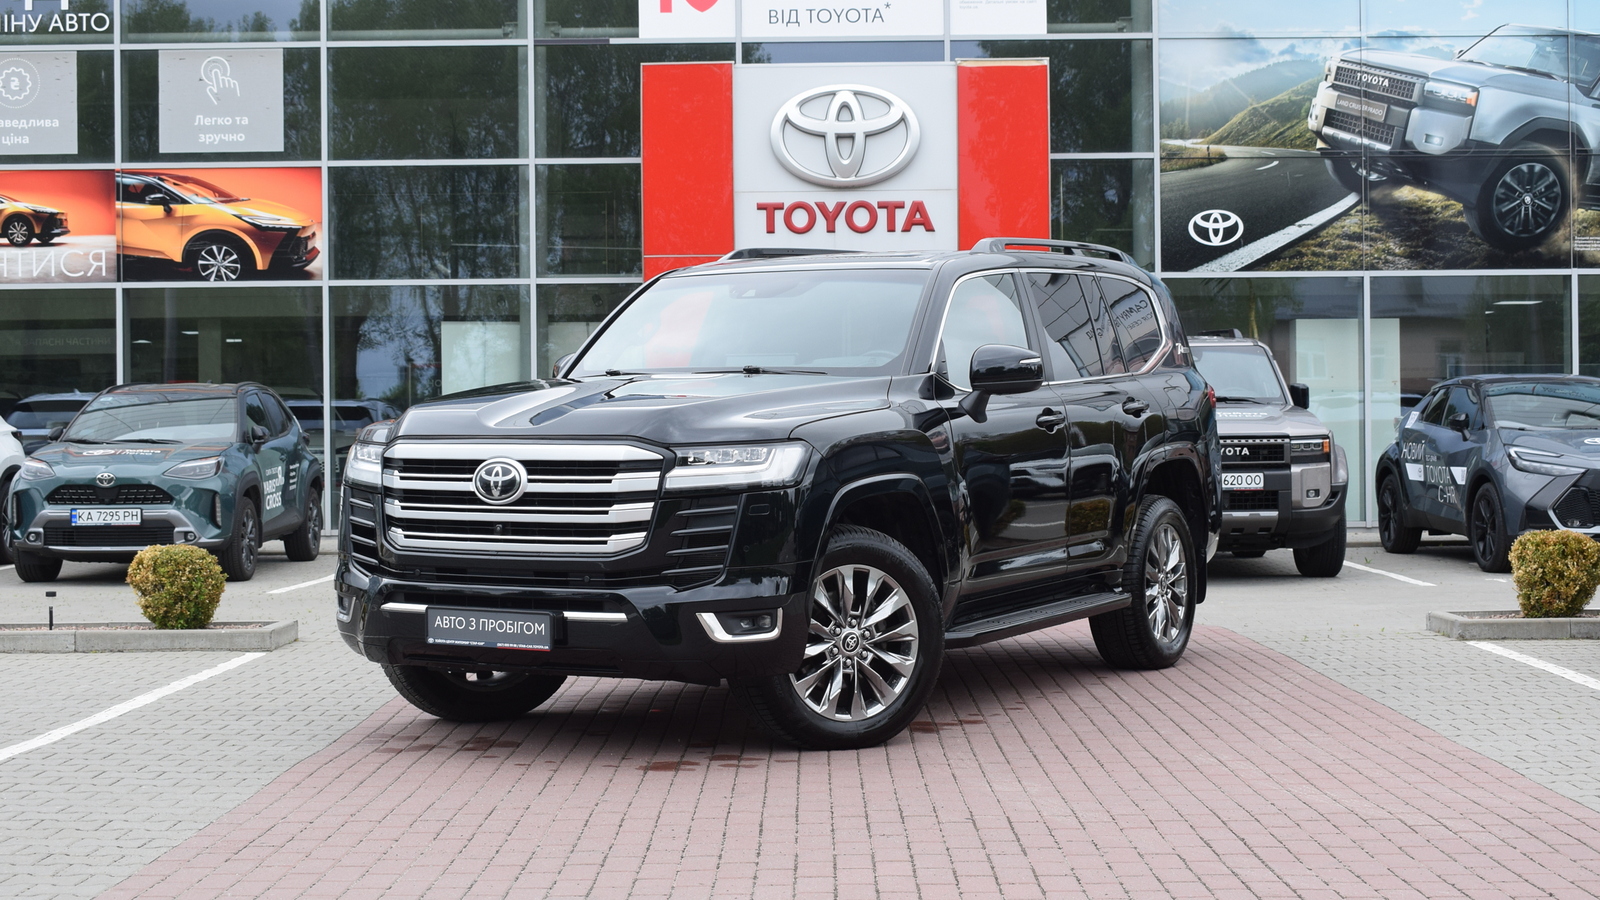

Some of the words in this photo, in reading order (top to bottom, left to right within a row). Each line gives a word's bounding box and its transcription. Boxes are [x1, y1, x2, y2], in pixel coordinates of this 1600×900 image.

[0, 14, 42, 33] ІНУ
[48, 12, 110, 32] АВТО
[768, 9, 801, 27] ВІД
[1356, 72, 1389, 87] TOYOTA
[1337, 100, 1348, 108] LAND
[1368, 106, 1384, 116] PRADO
[194, 115, 232, 126] Легко
[235, 116, 249, 125] та
[2, 133, 30, 146] ціна
[198, 133, 246, 145] зручно
[756, 200, 936, 234] TOYOTA
[1401, 440, 1426, 460] НОВИЙ
[1425, 465, 1452, 484] TOYOTA
[1438, 485, 1458, 504] C-HR
[96, 510, 121, 522] 7295
[434, 615, 466, 630] АВТО
[479, 618, 545, 636] ПРОБІГОМ
